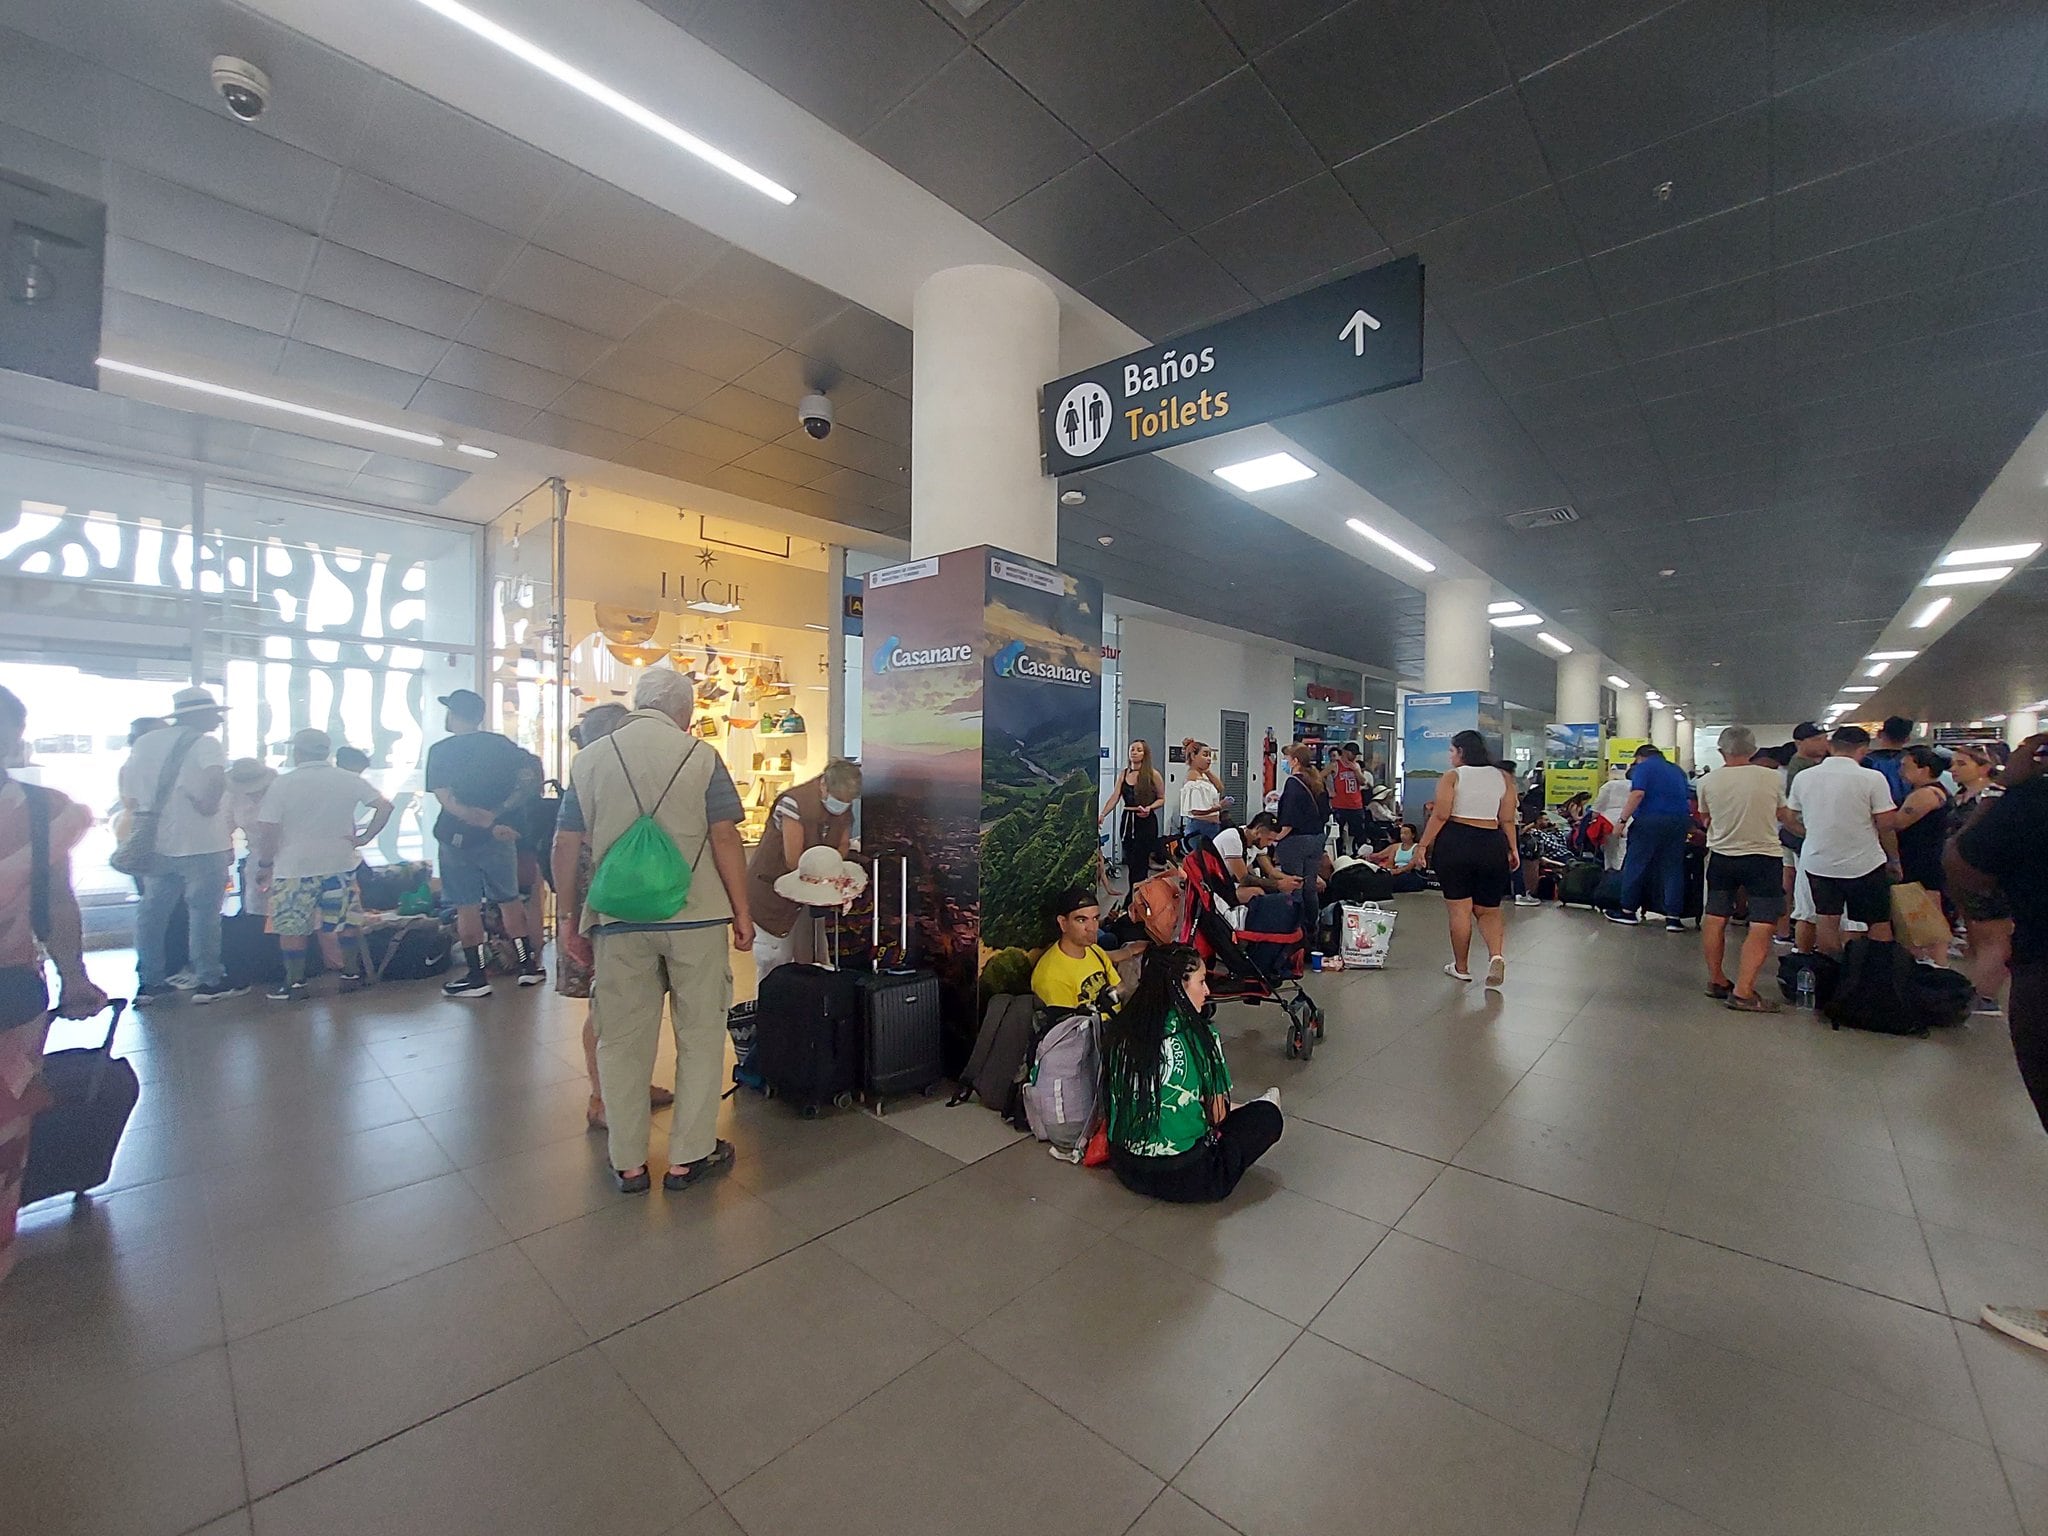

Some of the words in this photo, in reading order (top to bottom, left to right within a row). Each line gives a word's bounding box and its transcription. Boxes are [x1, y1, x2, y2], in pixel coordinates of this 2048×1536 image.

[1124, 347, 1215, 397] Baños
[1125, 389, 1229, 441] Toilets
[891, 645, 972, 667] Casanare
[1017, 655, 1091, 684] Casanare
